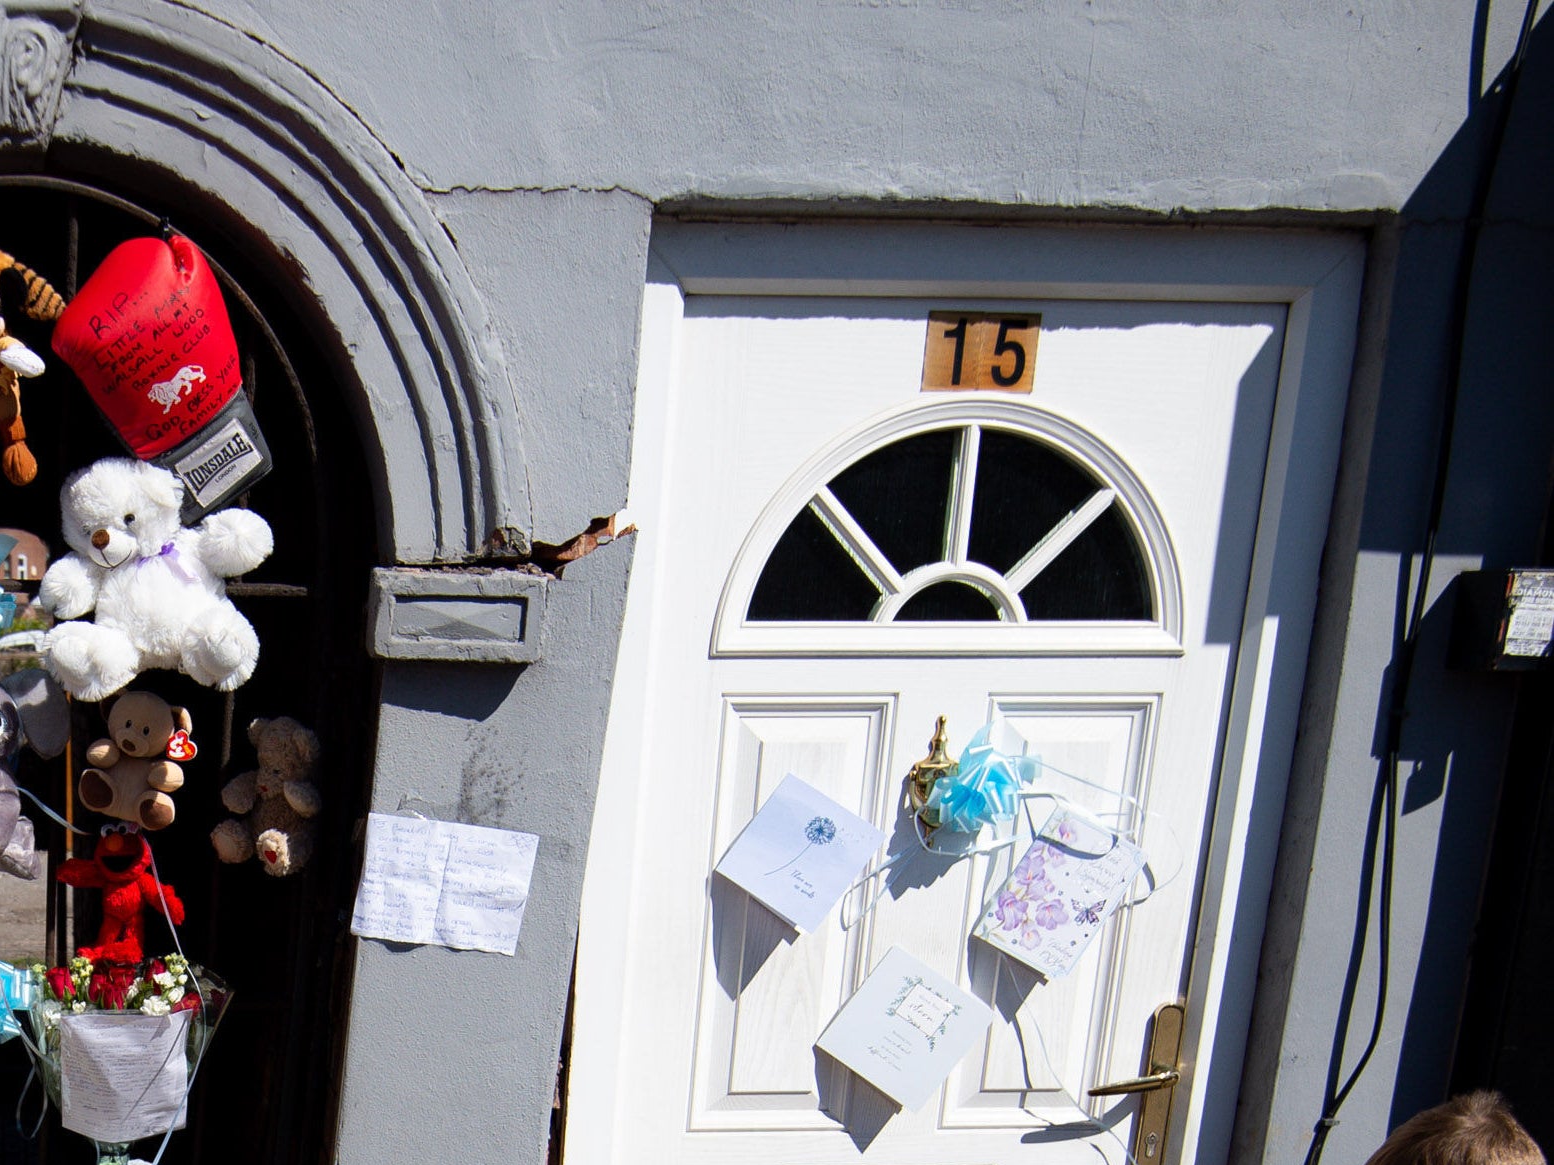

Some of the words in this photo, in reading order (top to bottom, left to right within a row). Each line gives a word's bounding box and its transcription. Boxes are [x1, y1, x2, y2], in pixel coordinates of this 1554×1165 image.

[92, 322, 147, 370] LITTLE
[109, 342, 143, 374] FROM
[152, 318, 170, 339] ALL
[131, 356, 181, 392] BOXING
[182, 326, 211, 353] CLUB
[943, 318, 1028, 387] 15
[102, 347, 164, 395] WALSALL
[145, 415, 181, 442] GOD
[178, 395, 225, 435] FAMILY
[183, 431, 254, 496] LONSDALE
[213, 463, 238, 483] LONDON
